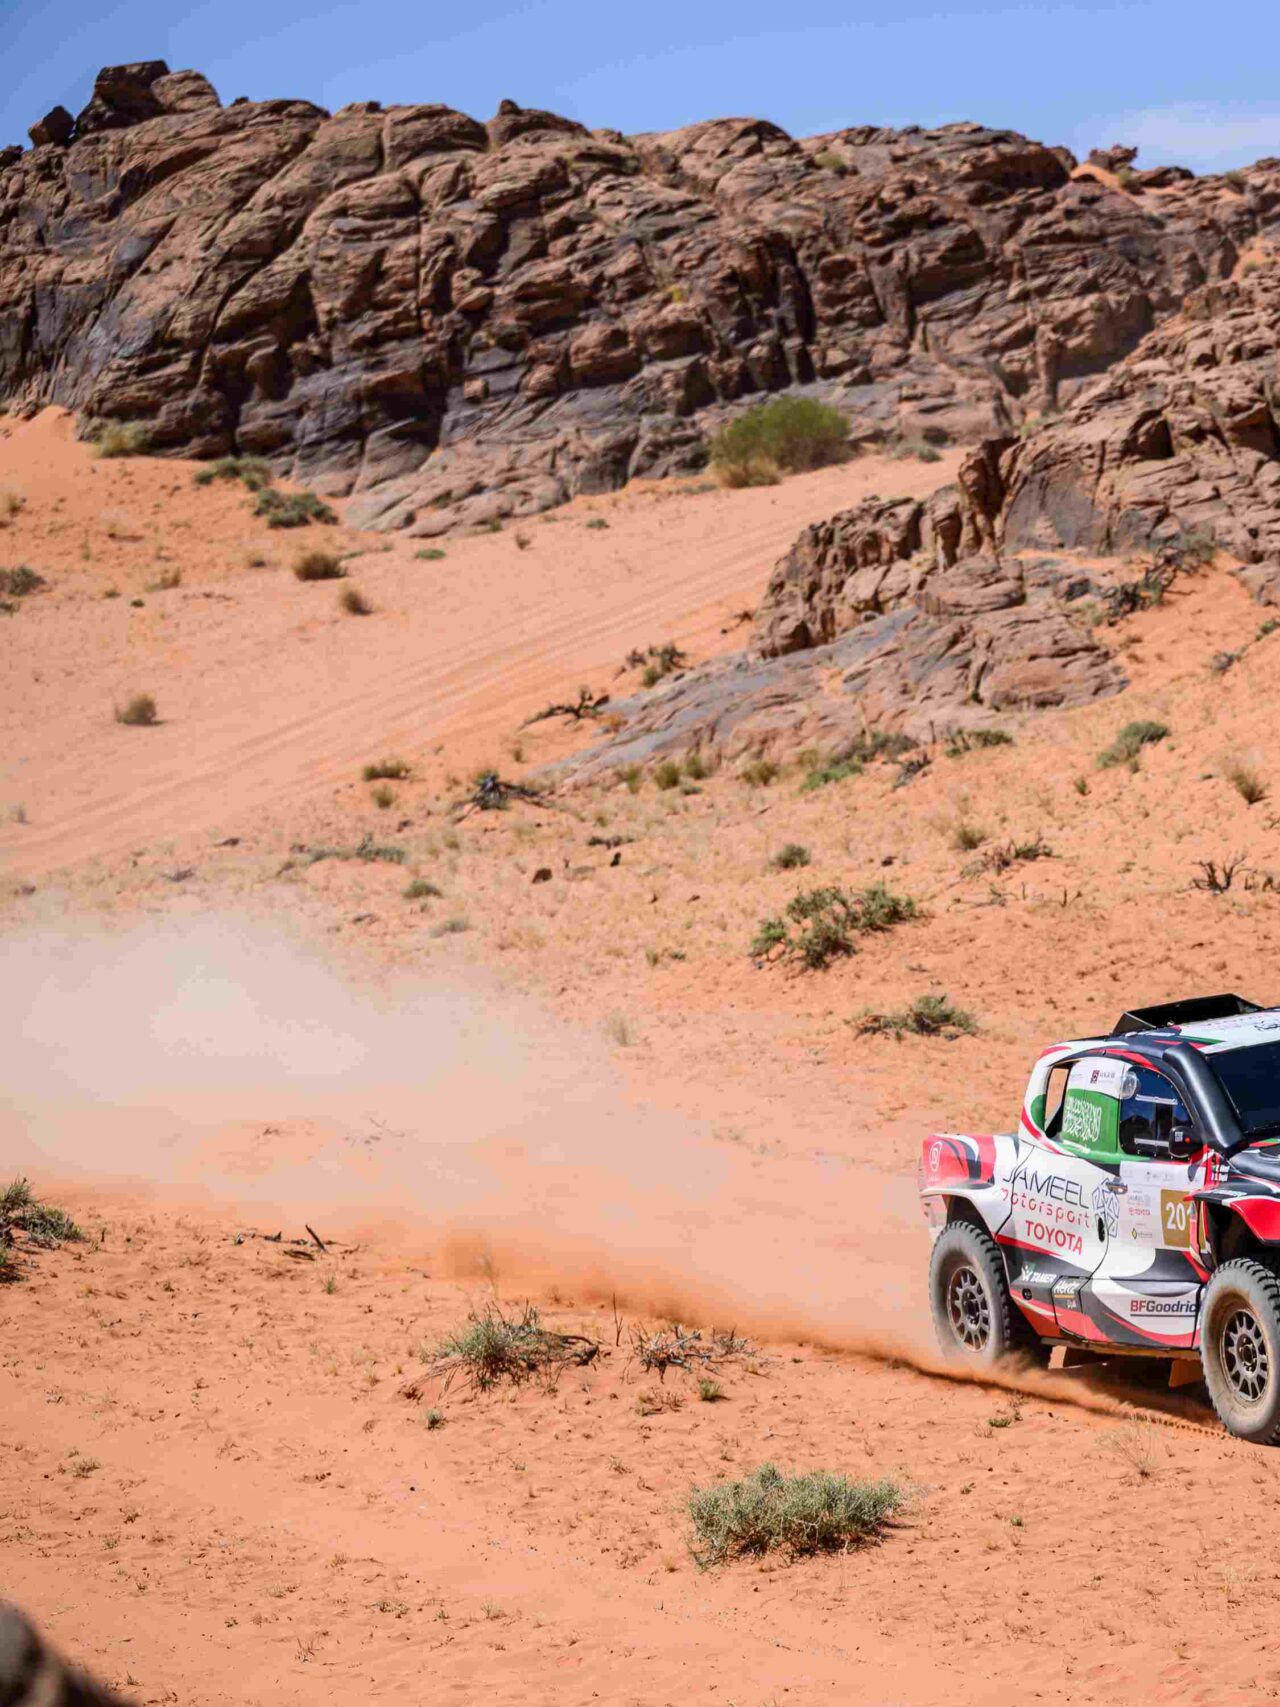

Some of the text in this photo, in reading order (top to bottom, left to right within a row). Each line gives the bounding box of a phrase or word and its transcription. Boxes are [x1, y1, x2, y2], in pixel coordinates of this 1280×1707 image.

[1003, 1167, 1089, 1209] JAMEEL
[1026, 1220, 1083, 1255] TOYOTA
[1053, 1280, 1081, 1294] Hertz
[1130, 1300, 1198, 1313] BFGoodric
